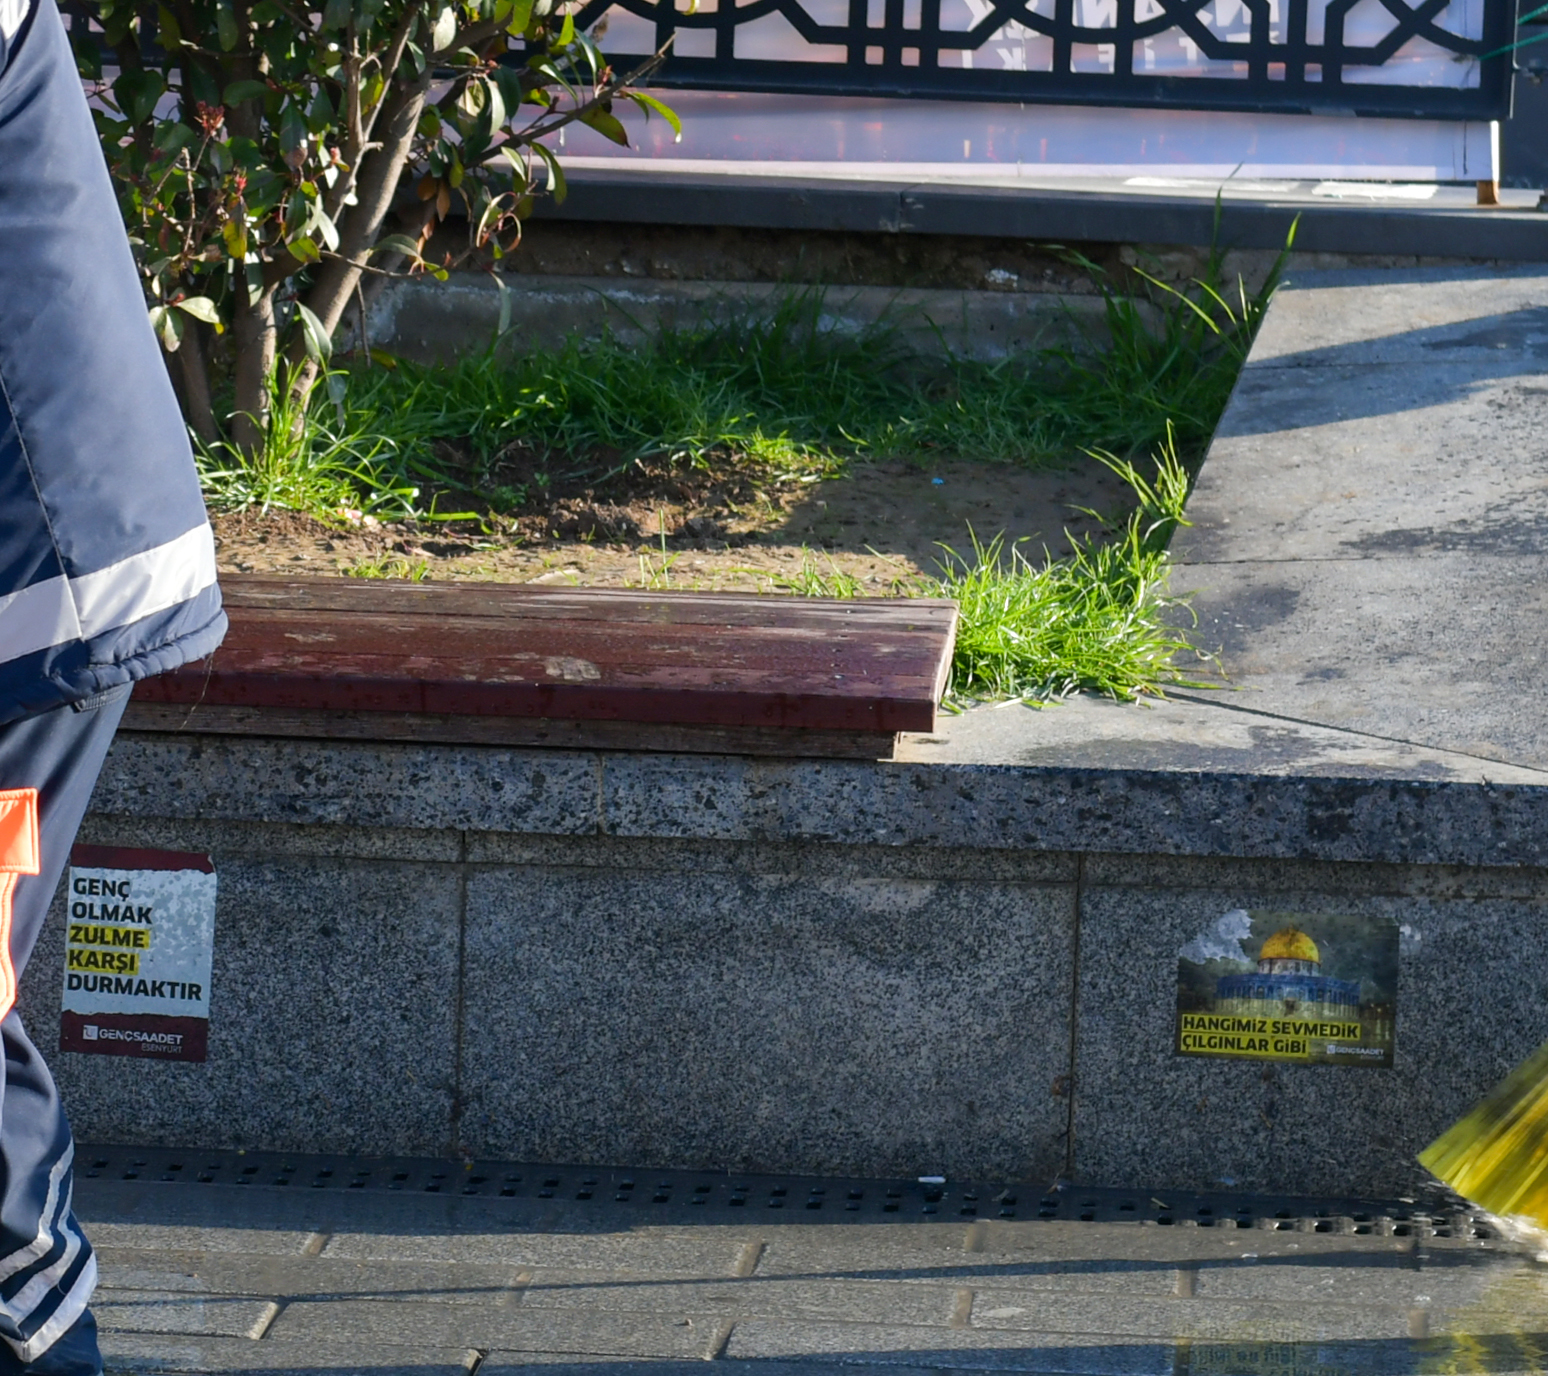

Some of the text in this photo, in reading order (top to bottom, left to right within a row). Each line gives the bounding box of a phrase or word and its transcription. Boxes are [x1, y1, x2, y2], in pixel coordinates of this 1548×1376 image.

[73, 877, 131, 902] GENÇ
[71, 901, 153, 925] OLMAK
[69, 925, 145, 948] ZULME
[68, 949, 136, 974] KARŞI
[67, 973, 202, 1001] DURMAKTIR
[99, 1027, 184, 1045] GENÇSAADET
[1182, 1033, 1270, 1052] ÇILGINLAR
[140, 1042, 182, 1054] ESENYURT
